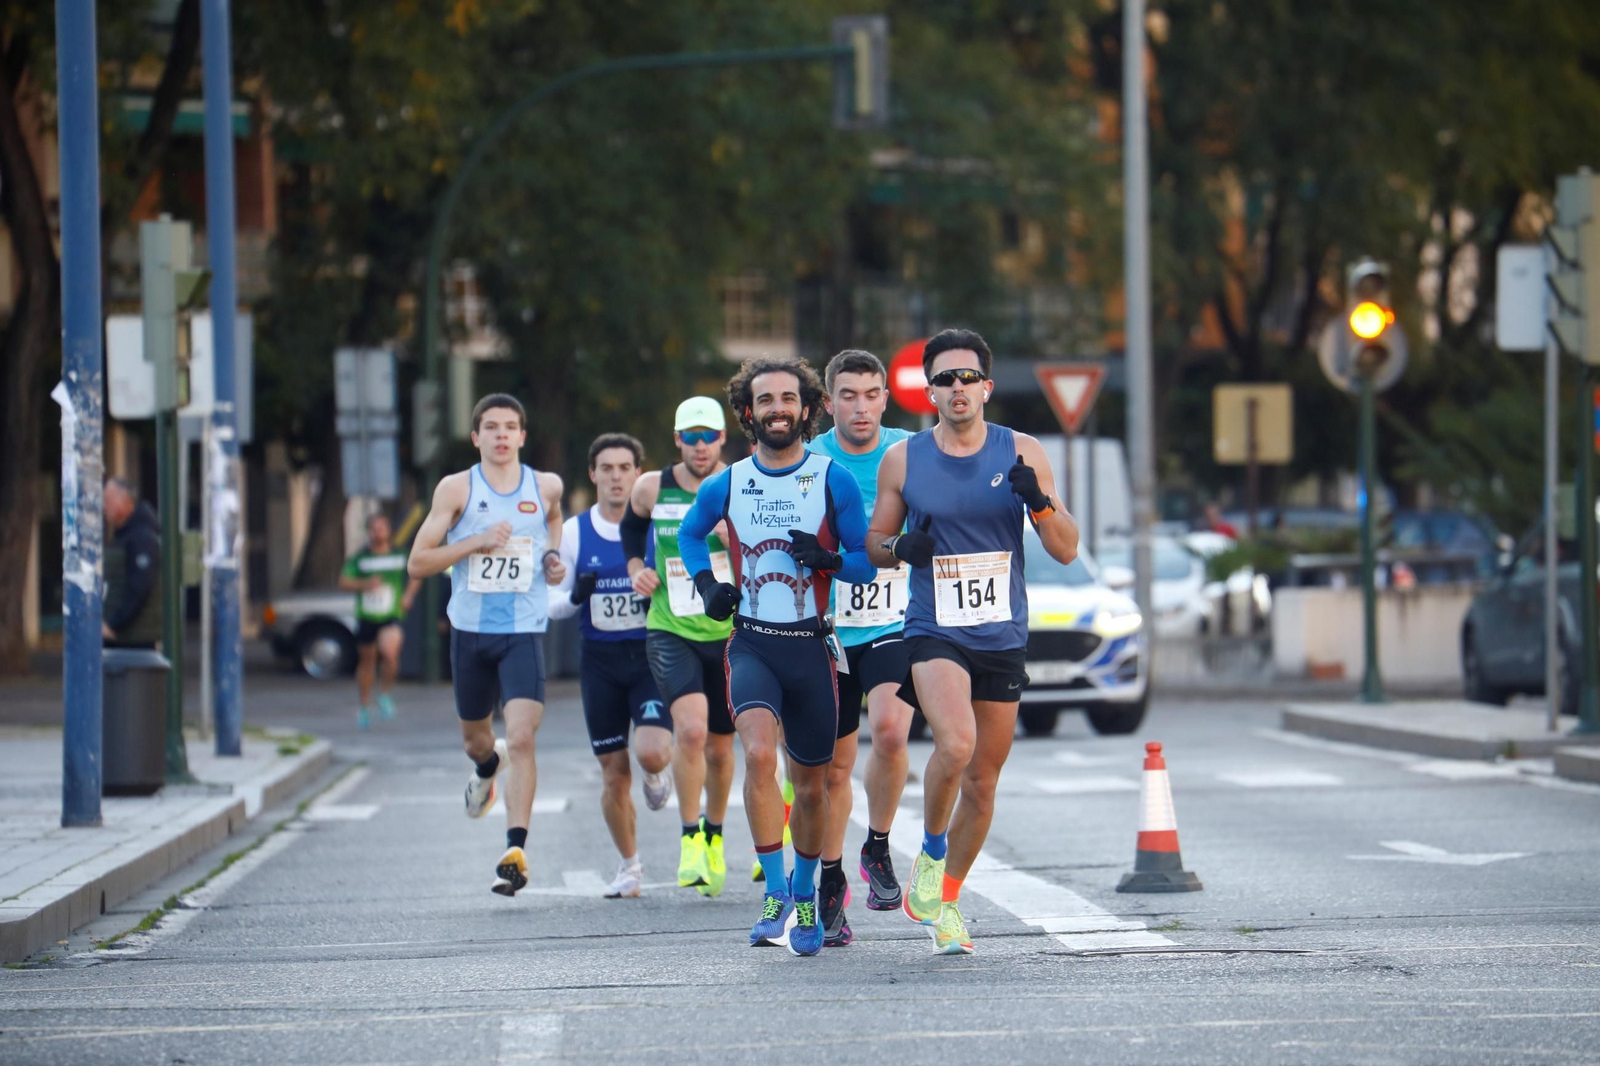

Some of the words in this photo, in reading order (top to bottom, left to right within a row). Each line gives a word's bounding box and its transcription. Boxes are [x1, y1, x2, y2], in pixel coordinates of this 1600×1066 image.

[741, 488, 764, 496] VIATOR
[481, 556, 520, 580] 275
[935, 557, 960, 579] XLI
[602, 593, 642, 618] 325
[850, 581, 892, 611] 821
[952, 577, 996, 610] 154
[751, 624, 814, 637] VELOCHAMPION
